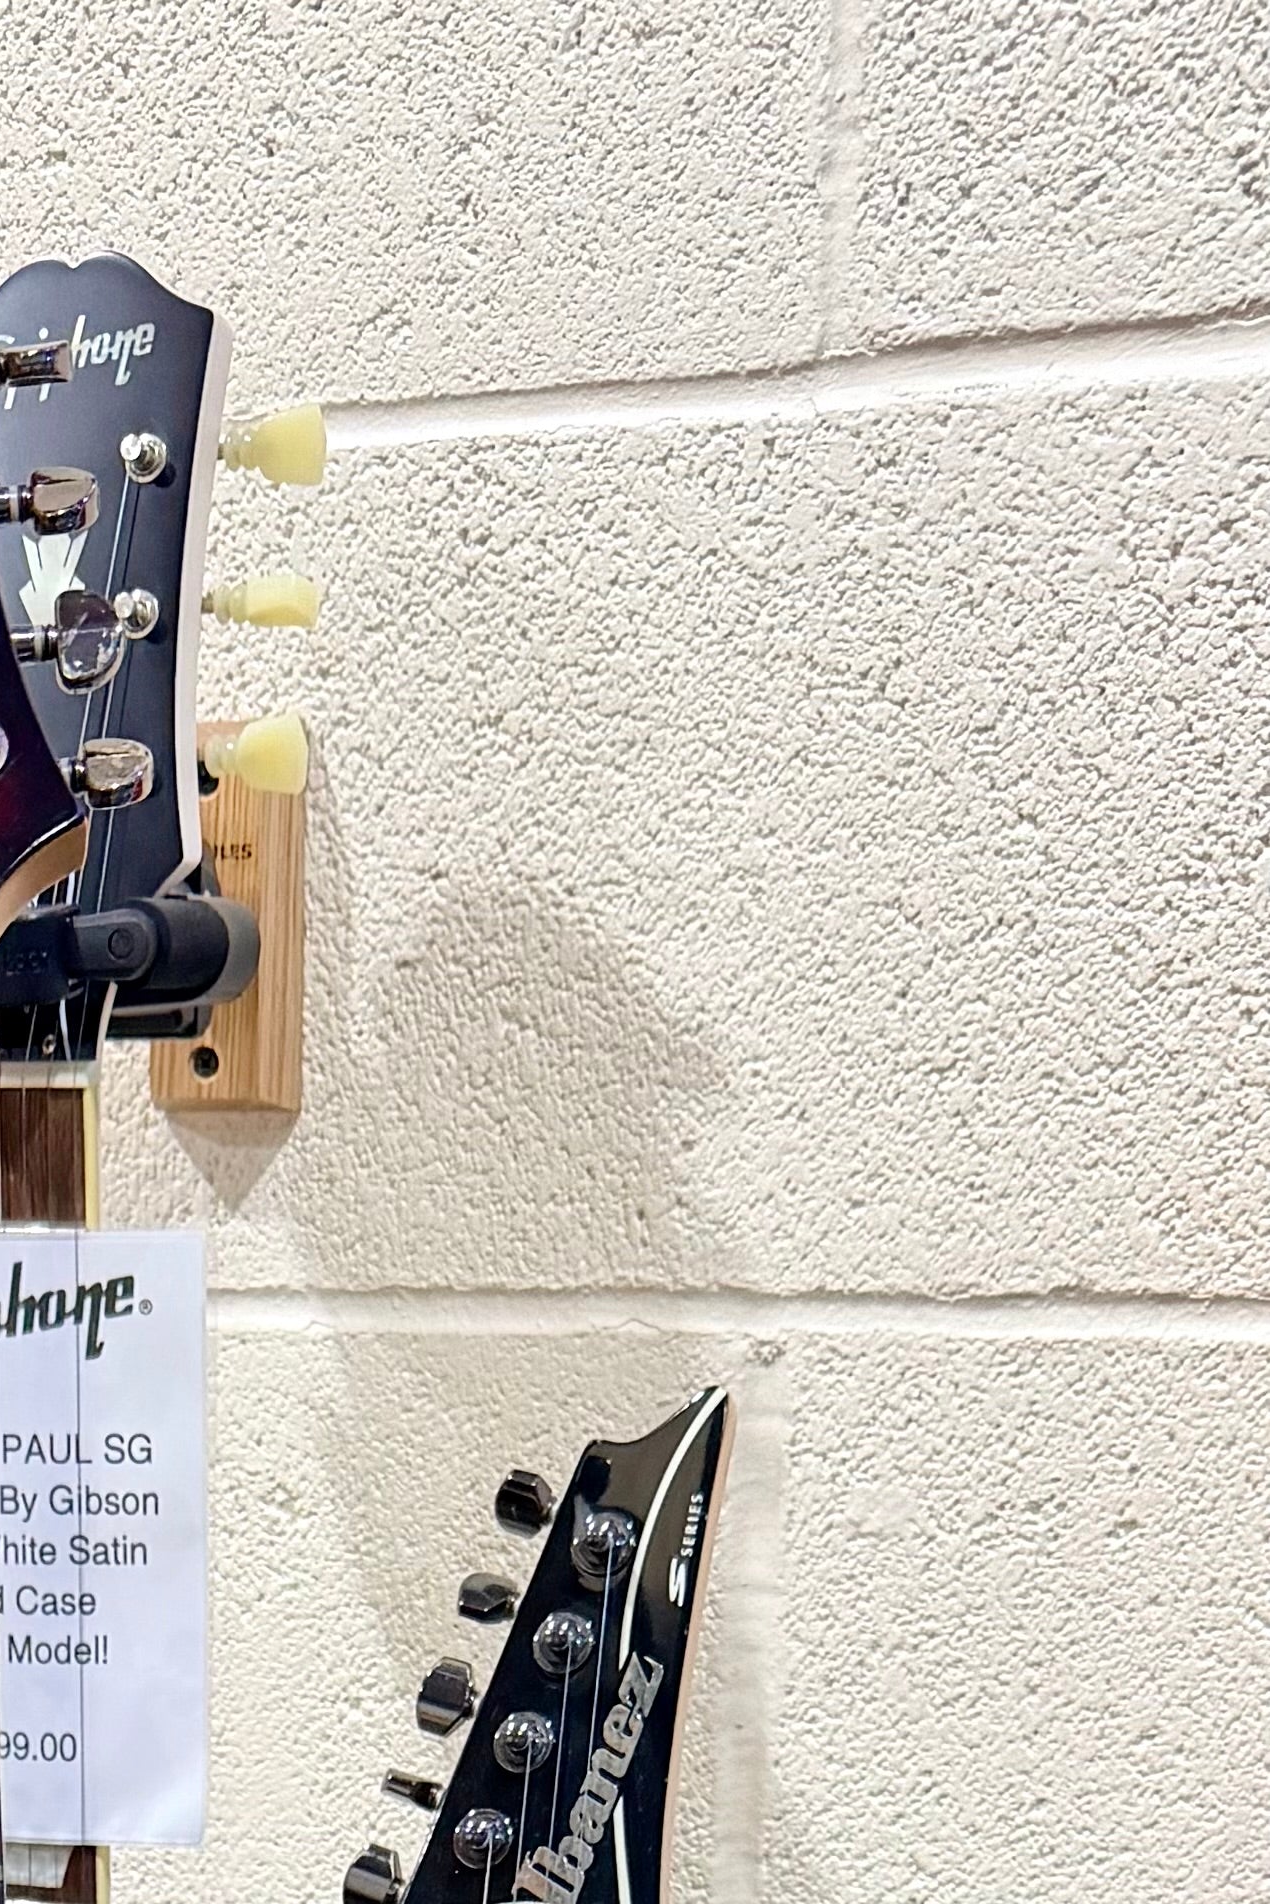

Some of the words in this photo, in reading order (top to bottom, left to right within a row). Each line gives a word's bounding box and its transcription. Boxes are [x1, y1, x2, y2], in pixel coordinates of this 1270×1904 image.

[2, 1433, 92, 1464] PAUL
[104, 1433, 153, 1465] SG
[0, 1485, 37, 1523] By
[49, 1484, 159, 1516] Gibson
[69, 1534, 148, 1566] Satin
[669, 1556, 686, 1608] S
[680, 1492, 704, 1557] SERIES
[15, 1585, 96, 1616] Case
[7, 1634, 108, 1665] Model!
